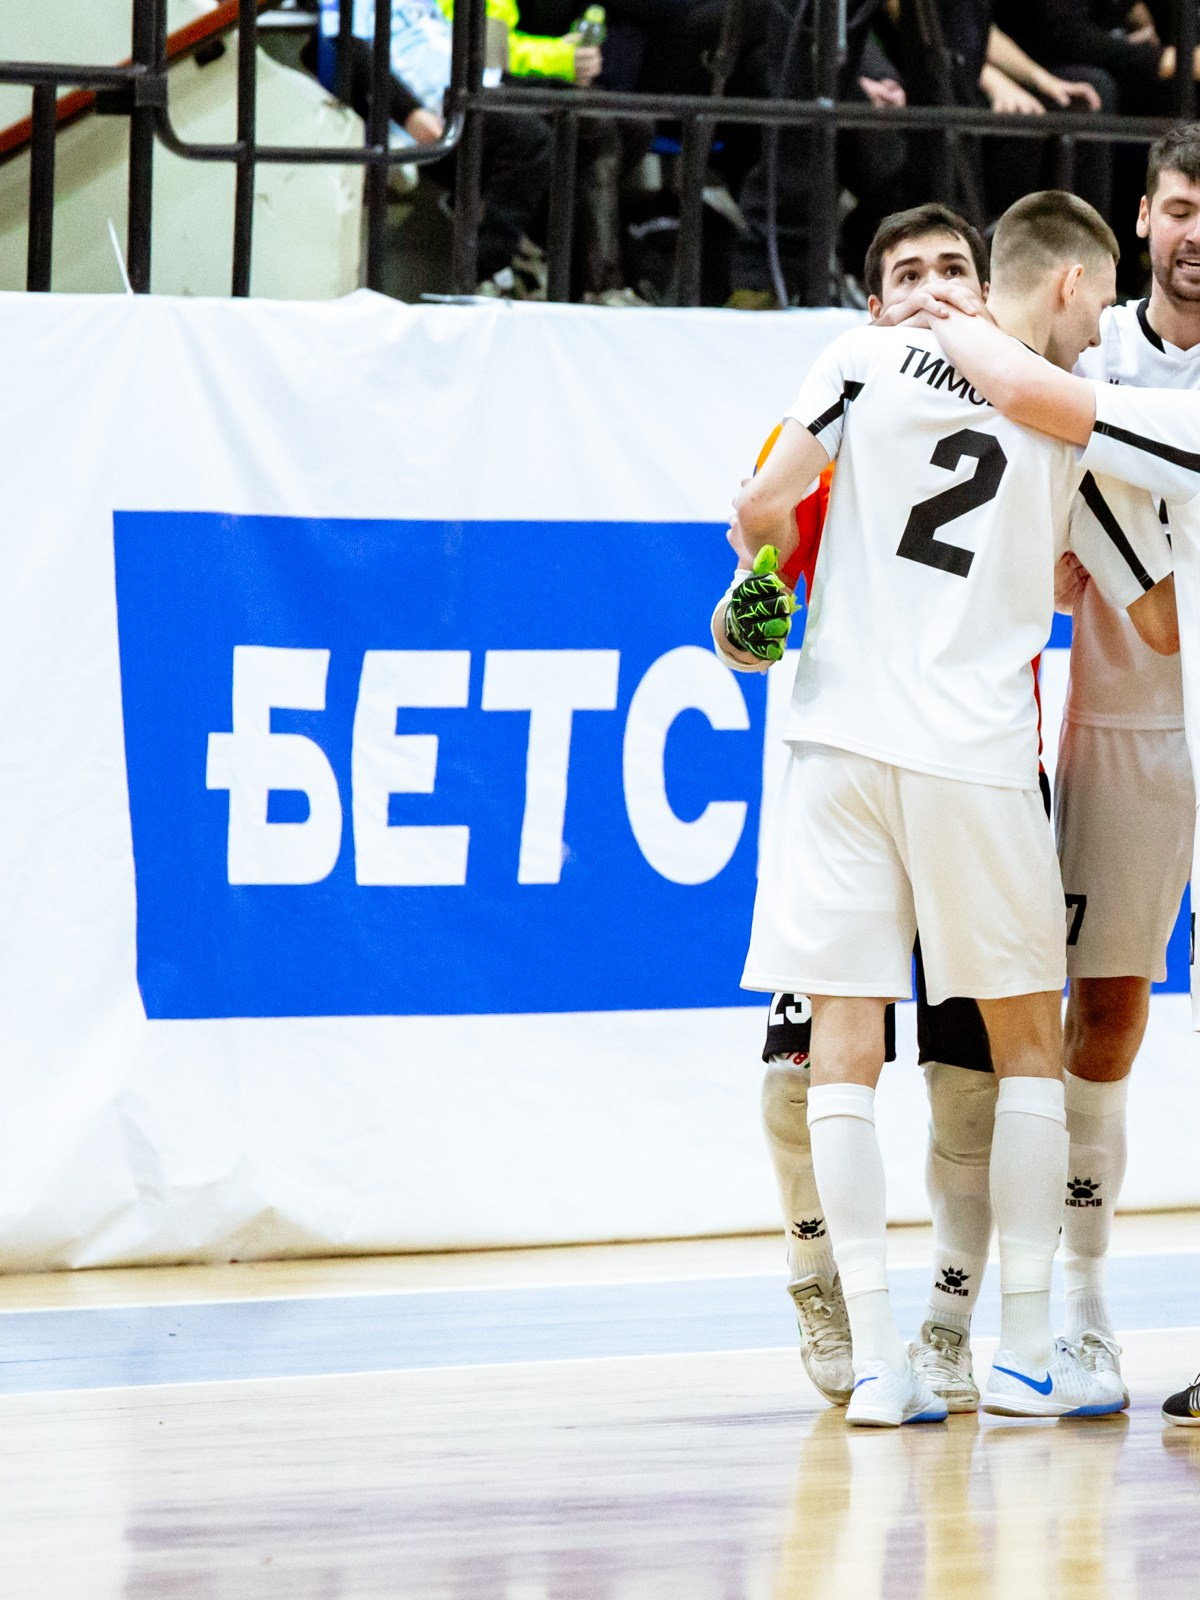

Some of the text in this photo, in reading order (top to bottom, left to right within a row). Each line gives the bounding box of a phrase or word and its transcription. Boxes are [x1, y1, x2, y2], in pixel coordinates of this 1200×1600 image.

[895, 428, 1009, 578] 2
[205, 644, 802, 887] БЕТС
[1064, 1198, 1103, 1208] KELME
[934, 1281, 969, 1297] KELME
